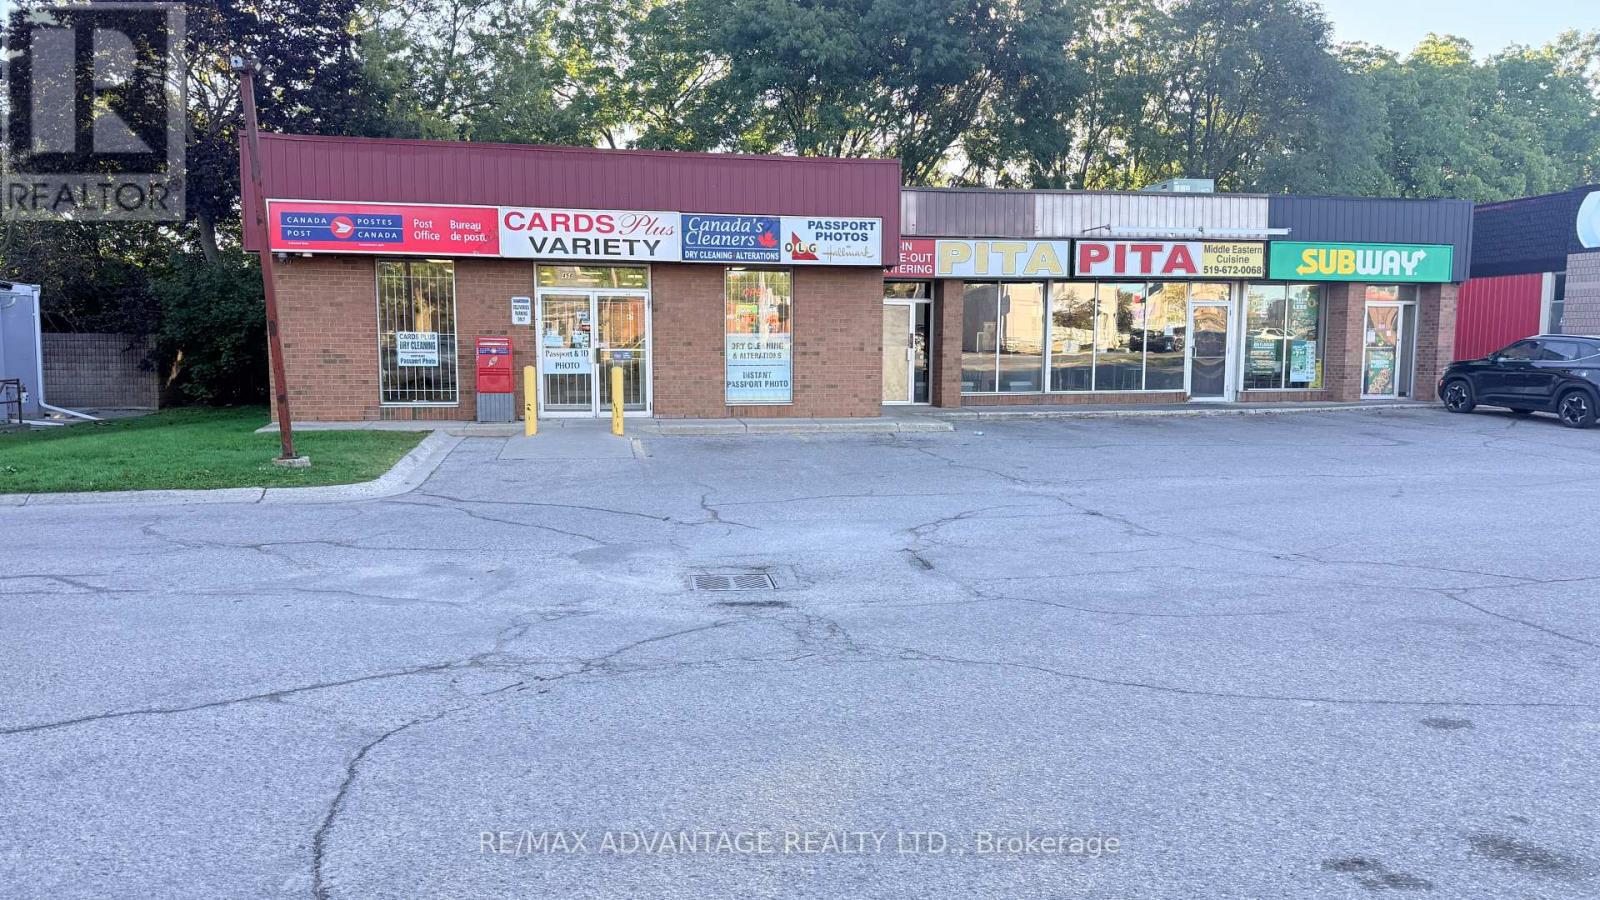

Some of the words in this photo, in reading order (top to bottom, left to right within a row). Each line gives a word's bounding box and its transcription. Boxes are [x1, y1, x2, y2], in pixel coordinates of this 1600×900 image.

[286, 216, 328, 225] CANADA
[357, 218, 393, 226] POSTES
[413, 218, 433, 229] Post
[450, 219, 481, 230] Bureau
[504, 211, 616, 234] CARDS
[618, 213, 675, 237] Plus
[688, 216, 764, 233] Canada's
[807, 220, 876, 231] PASSPORT
[287, 229, 312, 237] POST
[357, 231, 398, 239] CANADA
[414, 230, 440, 241] Office
[450, 231, 462, 241] de
[815, 232, 869, 242] PHOTOS
[685, 231, 755, 247] Cleaners
[528, 236, 661, 257] VARIETY
[1203, 244, 1230, 254] Middle
[1231, 245, 1262, 254] Eastern
[685, 250, 698, 260] DRY
[700, 251, 733, 260] CLEANING
[735, 251, 779, 261] ALTERATIONS
[900, 253, 933, 263] E-OUT
[938, 241, 1064, 275] PITA
[1079, 243, 1198, 274] PITA
[1216, 255, 1250, 264] Cuisine
[1296, 248, 1427, 277] SUBWAY
[1203, 265, 1262, 275] 519-672-0068
[410, 341, 436, 350] CLEANING
[545, 349, 573, 359] Passport
[555, 361, 580, 370] PHOTO
[742, 371, 772, 379] INSTANT
[727, 380, 762, 388] PASSPORT
[764, 380, 789, 388] PHOTO
